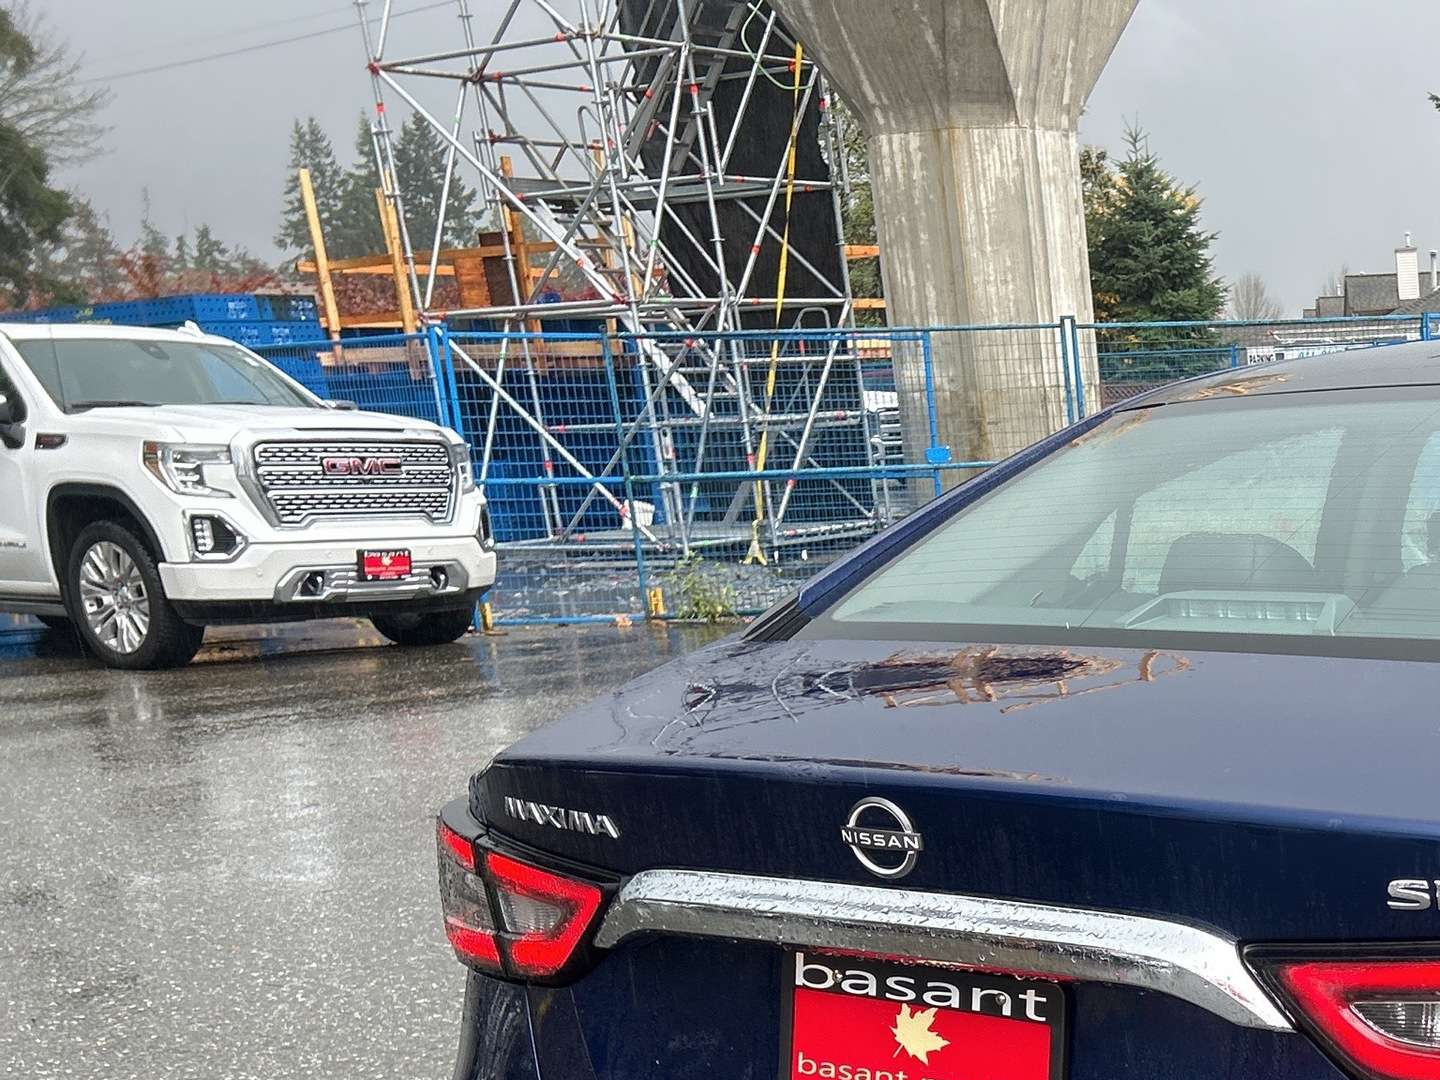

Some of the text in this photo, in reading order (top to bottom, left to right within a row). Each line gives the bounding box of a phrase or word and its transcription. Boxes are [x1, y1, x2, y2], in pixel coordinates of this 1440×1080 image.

[322, 457, 402, 475] GMC
[504, 796, 622, 839] MAXIMA
[841, 829, 920, 850] NISSAN
[795, 952, 1048, 1022] basant
